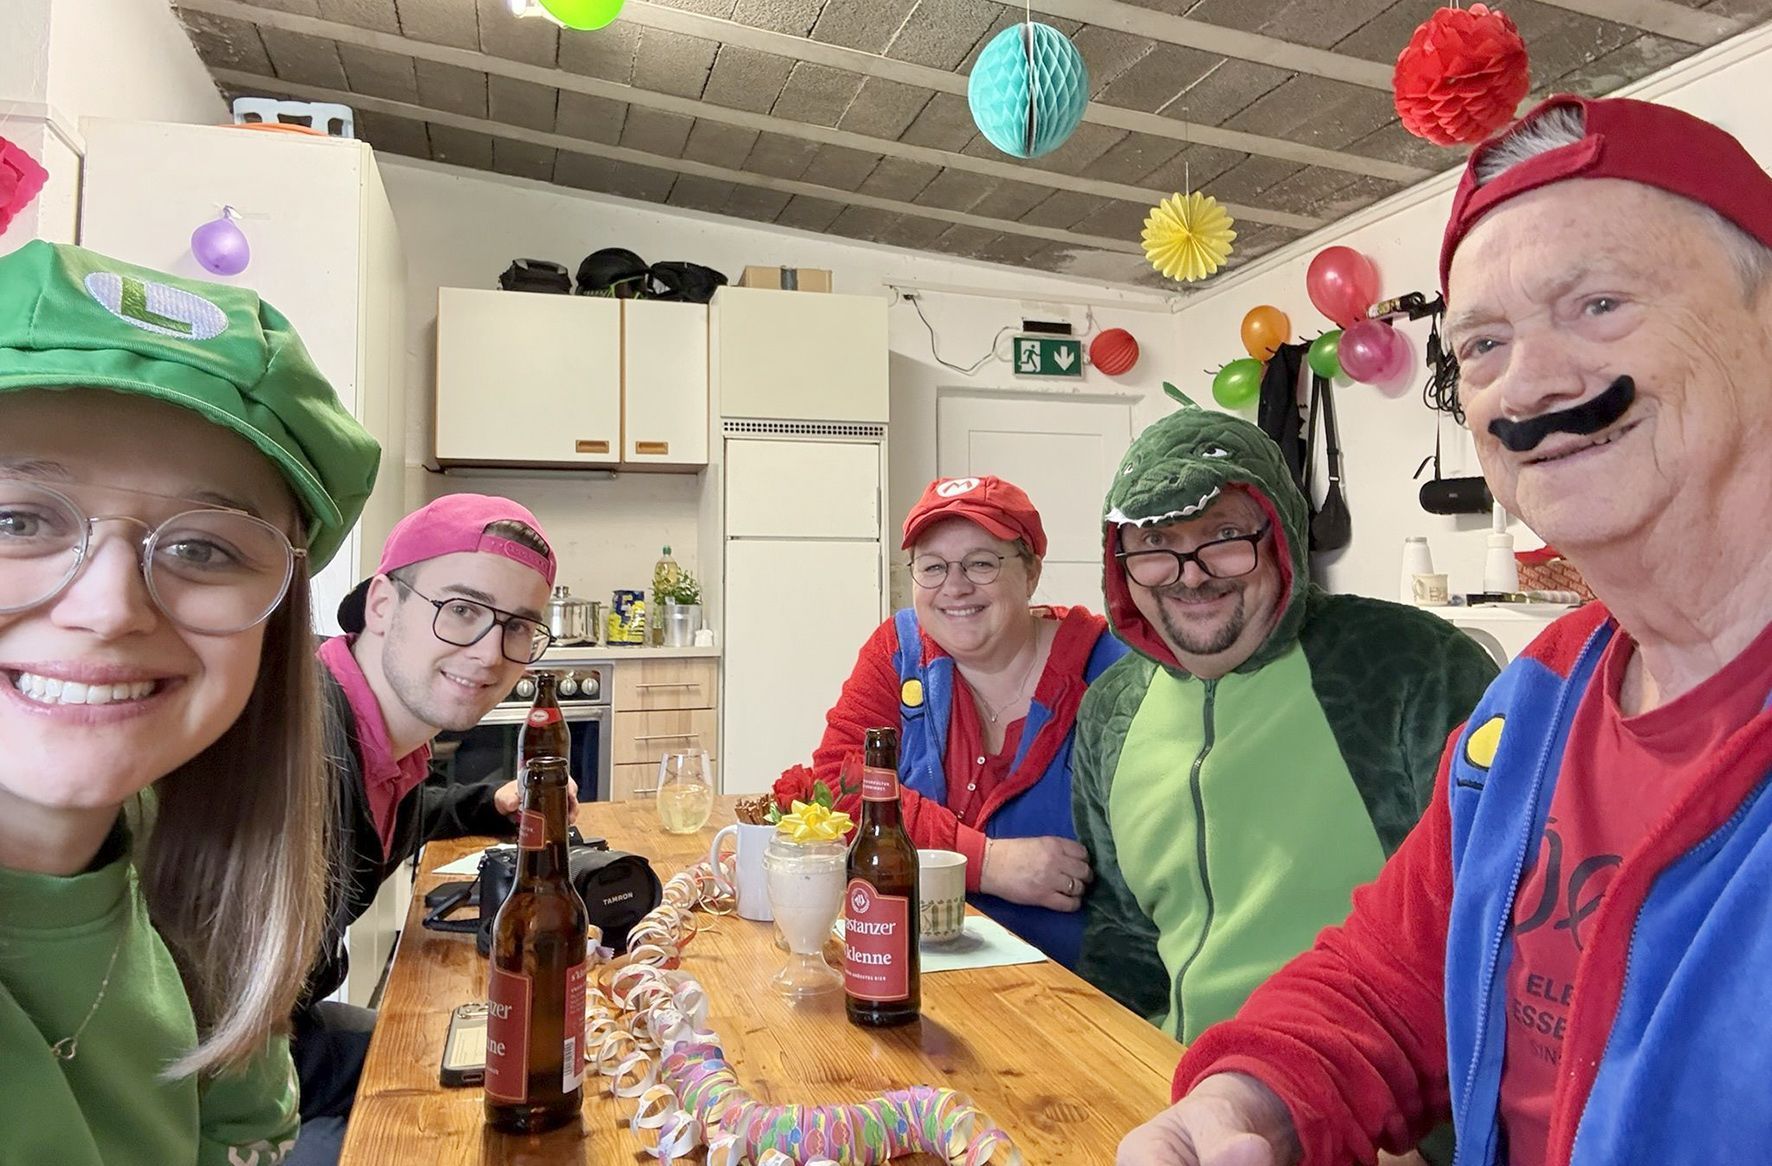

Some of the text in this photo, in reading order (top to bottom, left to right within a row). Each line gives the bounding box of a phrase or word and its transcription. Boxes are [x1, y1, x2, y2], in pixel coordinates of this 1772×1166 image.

[121, 276, 193, 335] L
[942, 480, 973, 494] M
[603, 891, 634, 905] TAMRON
[846, 918, 897, 935] stanzer
[845, 943, 893, 965] klenne
[1527, 973, 1574, 1007] ELE
[1512, 998, 1568, 1040] ESSE
[1529, 1040, 1563, 1066] SIN
